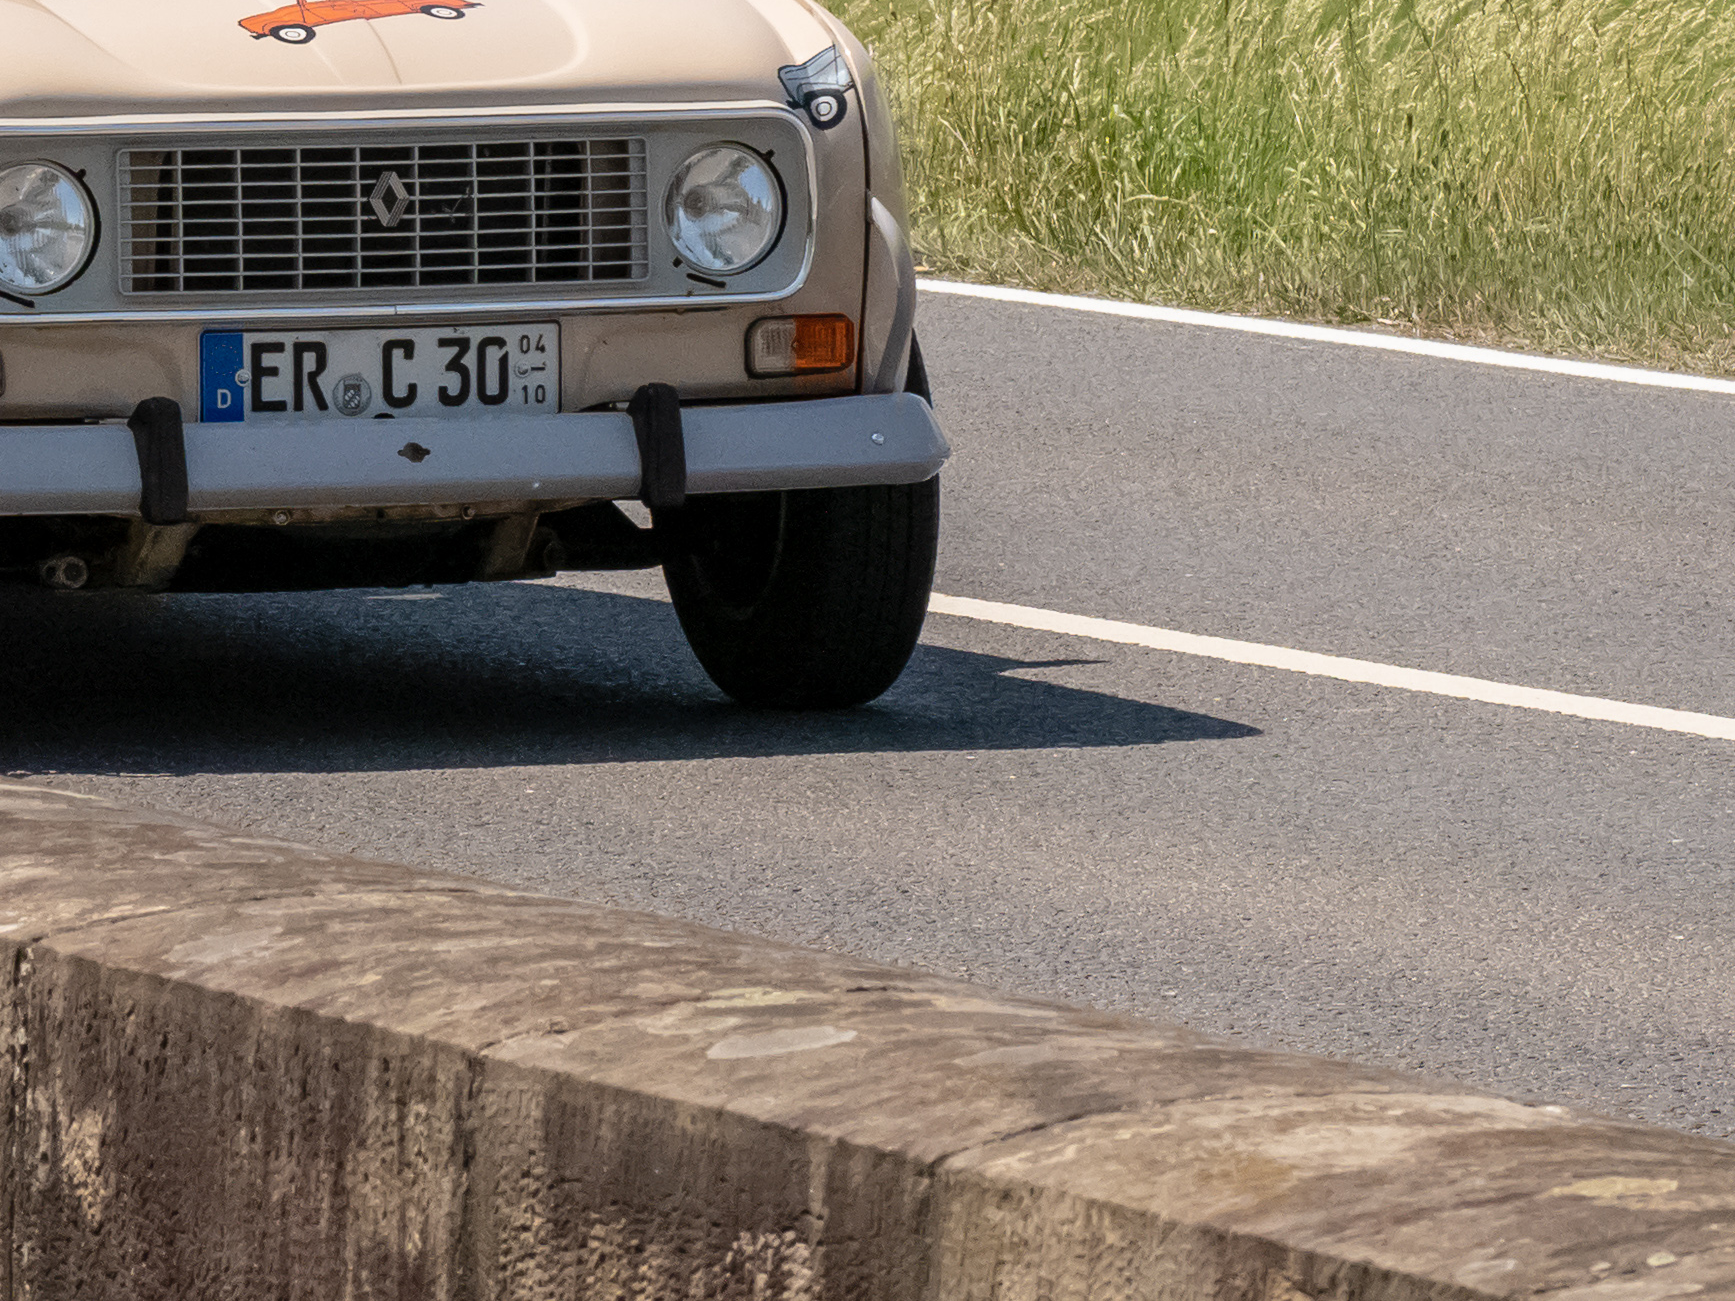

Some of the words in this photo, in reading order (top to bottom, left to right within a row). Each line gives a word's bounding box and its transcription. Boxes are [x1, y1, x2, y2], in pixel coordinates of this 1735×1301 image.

[519, 333, 547, 354] 04
[250, 340, 330, 412] ER
[382, 338, 418, 408] C
[437, 336, 510, 407] 30
[216, 389, 232, 409] D
[520, 384, 547, 405] 10
